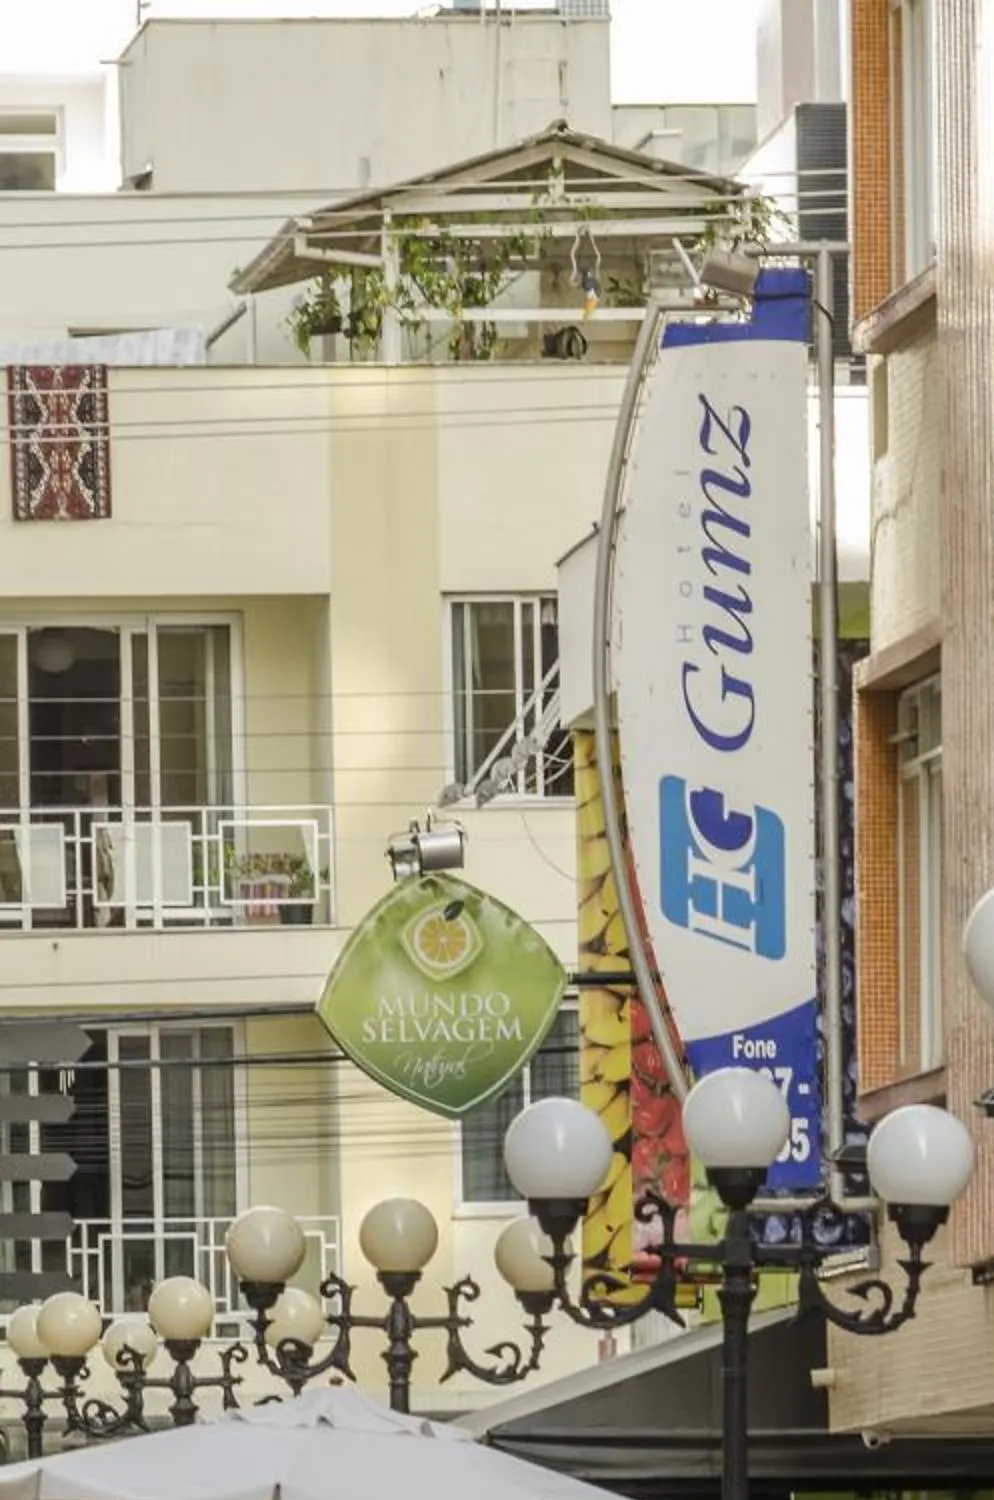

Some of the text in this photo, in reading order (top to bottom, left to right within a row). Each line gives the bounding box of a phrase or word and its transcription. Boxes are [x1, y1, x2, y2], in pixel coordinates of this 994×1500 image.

[675, 468, 694, 643] Hotel
[682, 393, 755, 753] Gumz
[377, 991, 511, 1018] MUNDO
[361, 1017, 523, 1042] SELVAGEM
[732, 1034, 777, 1059] Fone
